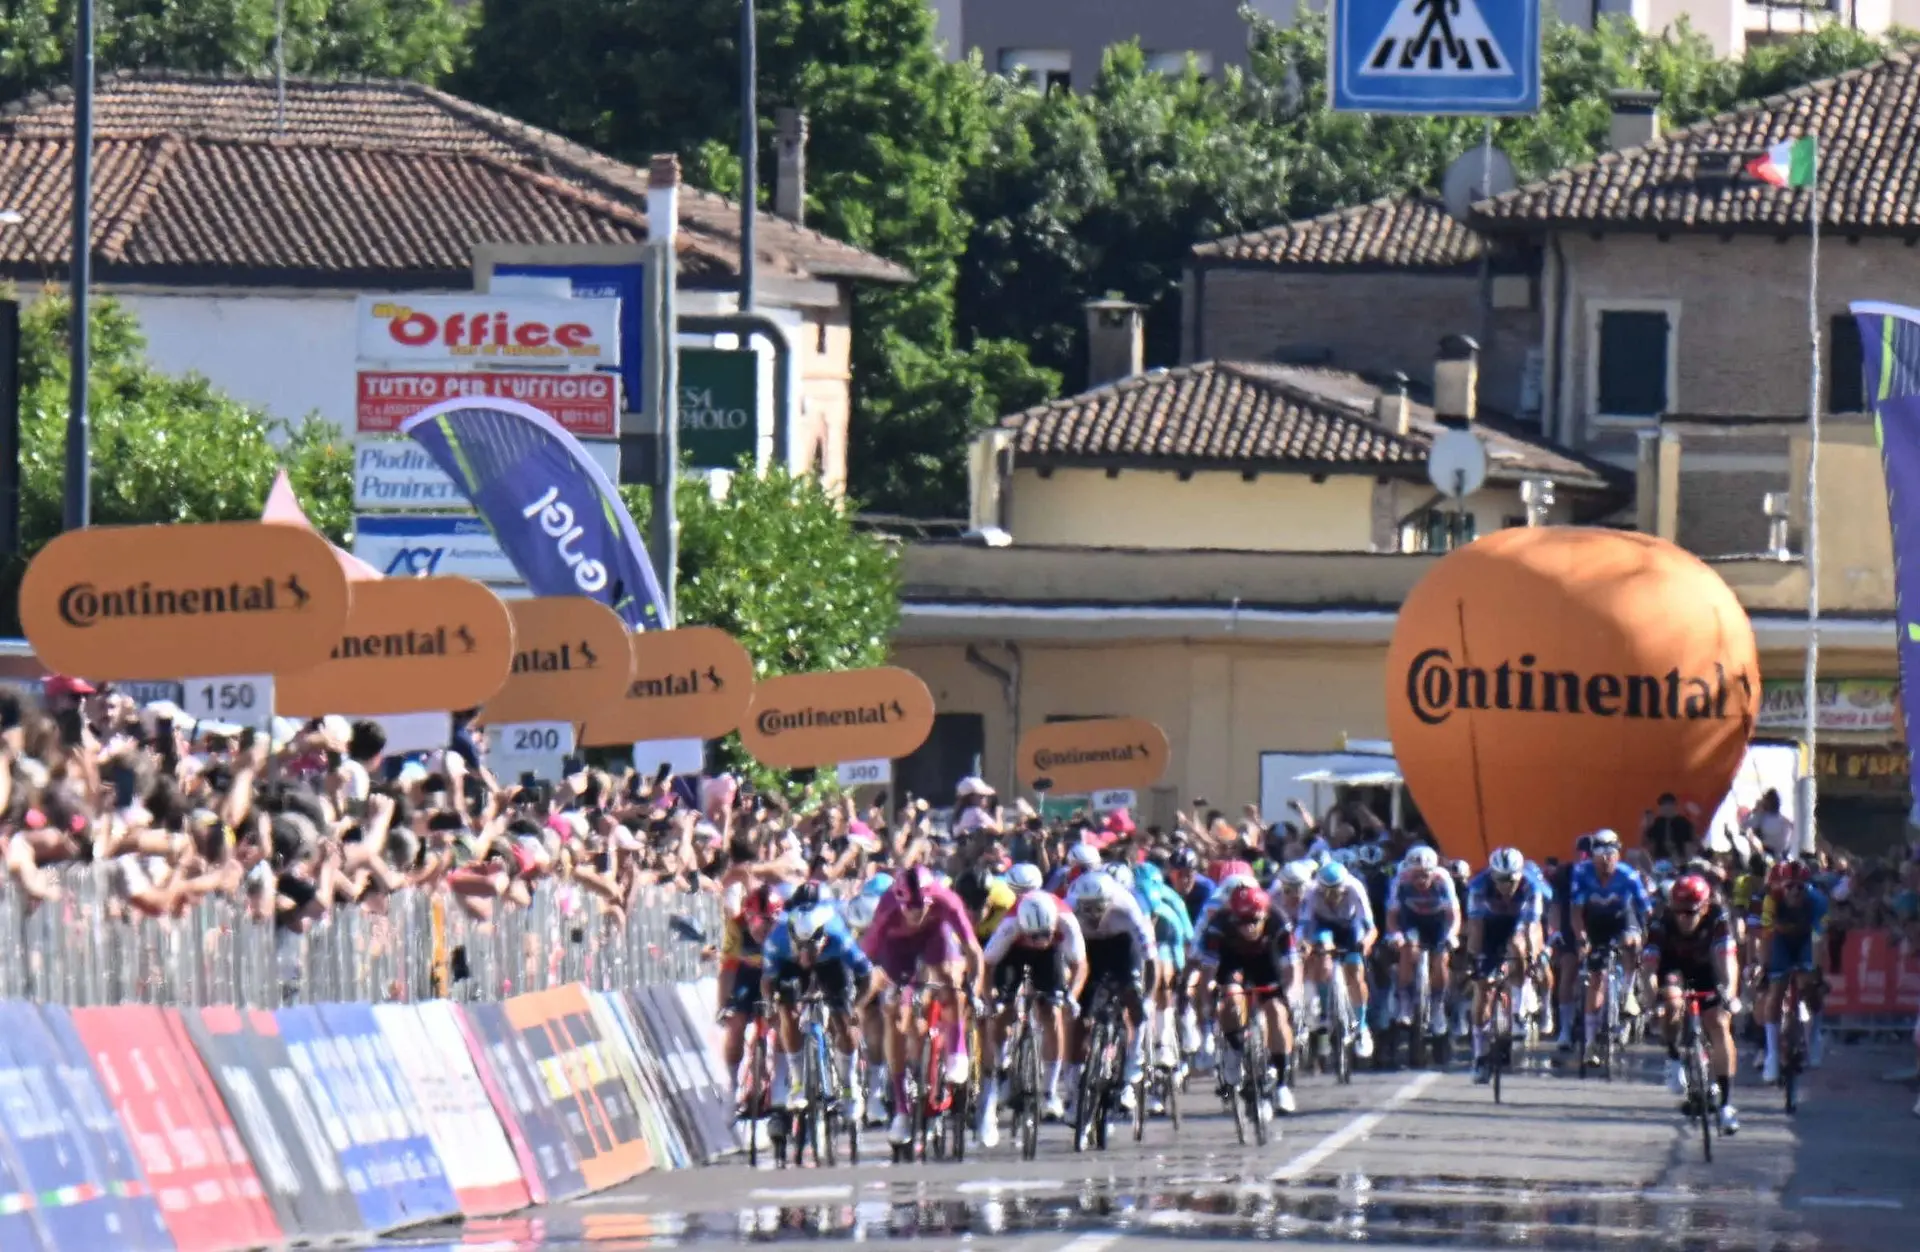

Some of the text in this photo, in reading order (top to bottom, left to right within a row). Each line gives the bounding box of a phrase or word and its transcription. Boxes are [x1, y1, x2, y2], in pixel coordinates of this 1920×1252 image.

[389, 311, 593, 346] Office
[364, 377, 608, 398] TUTTO PER L'UFFICIO
[360, 449, 435, 470] Piadin
[523, 486, 607, 592] enel
[58, 576, 275, 628] Continental
[201, 683, 256, 710] 150
[626, 669, 698, 698] ental
[1407, 648, 1727, 725] Continental
[757, 702, 888, 735] Continental
[514, 728, 559, 750] 200
[1034, 744, 1133, 771] Continental
[847, 765, 880, 780] 300
